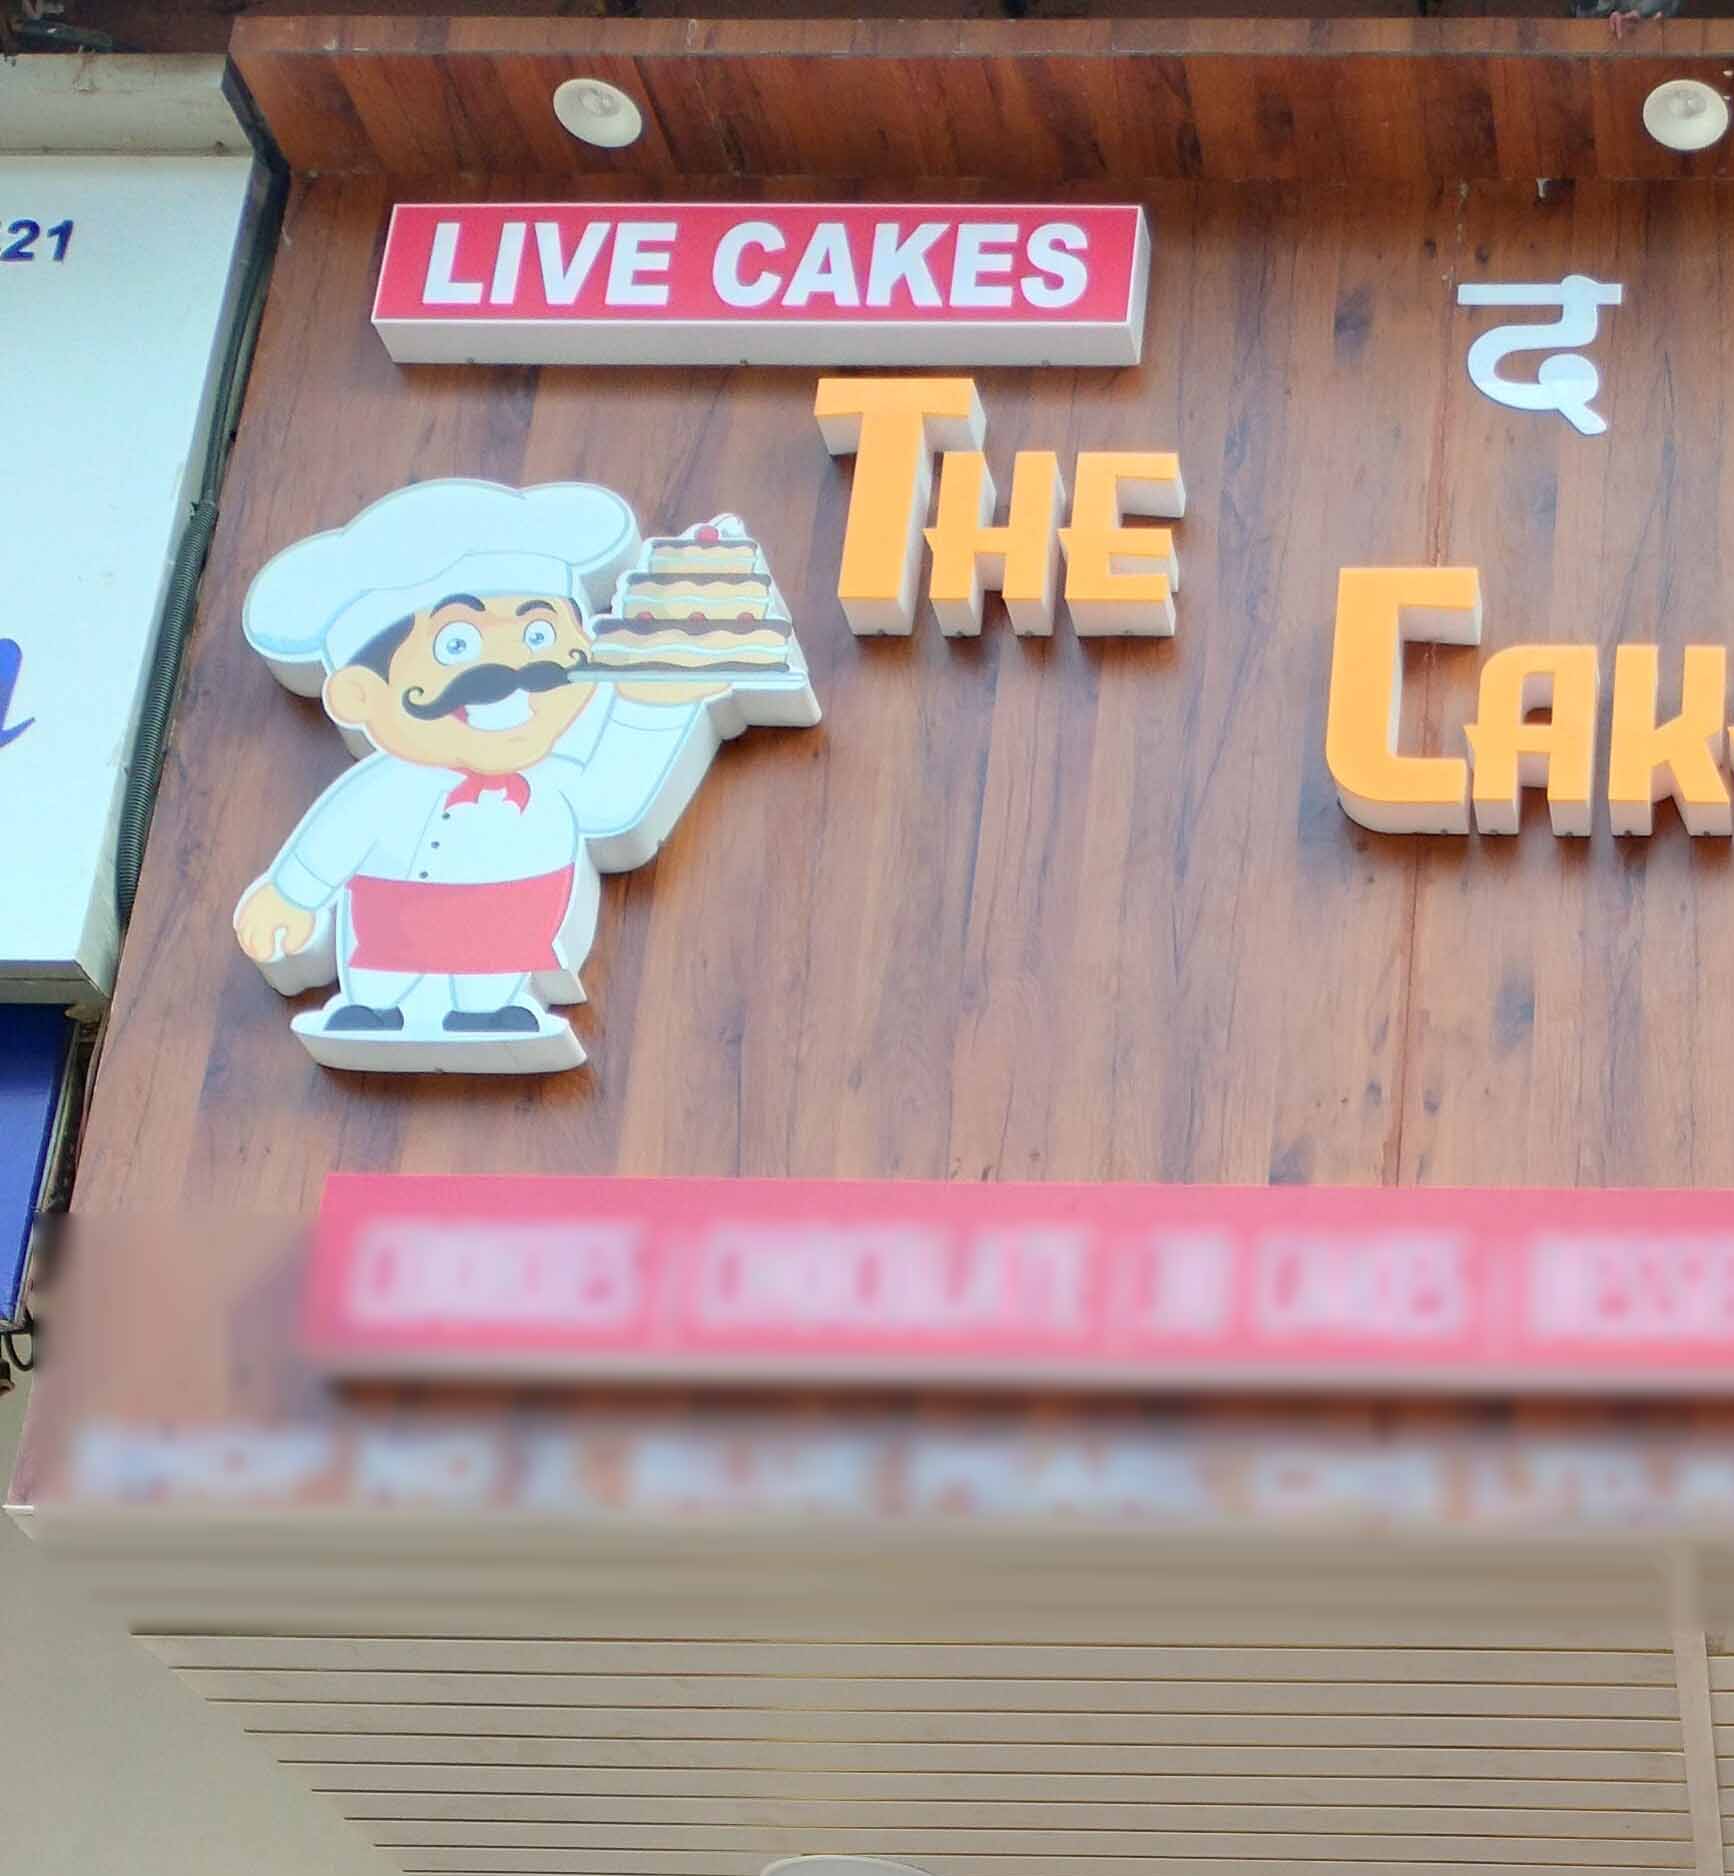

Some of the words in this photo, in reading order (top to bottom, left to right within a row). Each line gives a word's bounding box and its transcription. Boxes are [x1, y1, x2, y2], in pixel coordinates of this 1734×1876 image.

[0, 218, 75, 262] 21
[421, 219, 678, 307] LIVE
[710, 219, 1091, 309] CAKES
[1457, 274, 1623, 436] द
[814, 377, 1186, 637] THE
